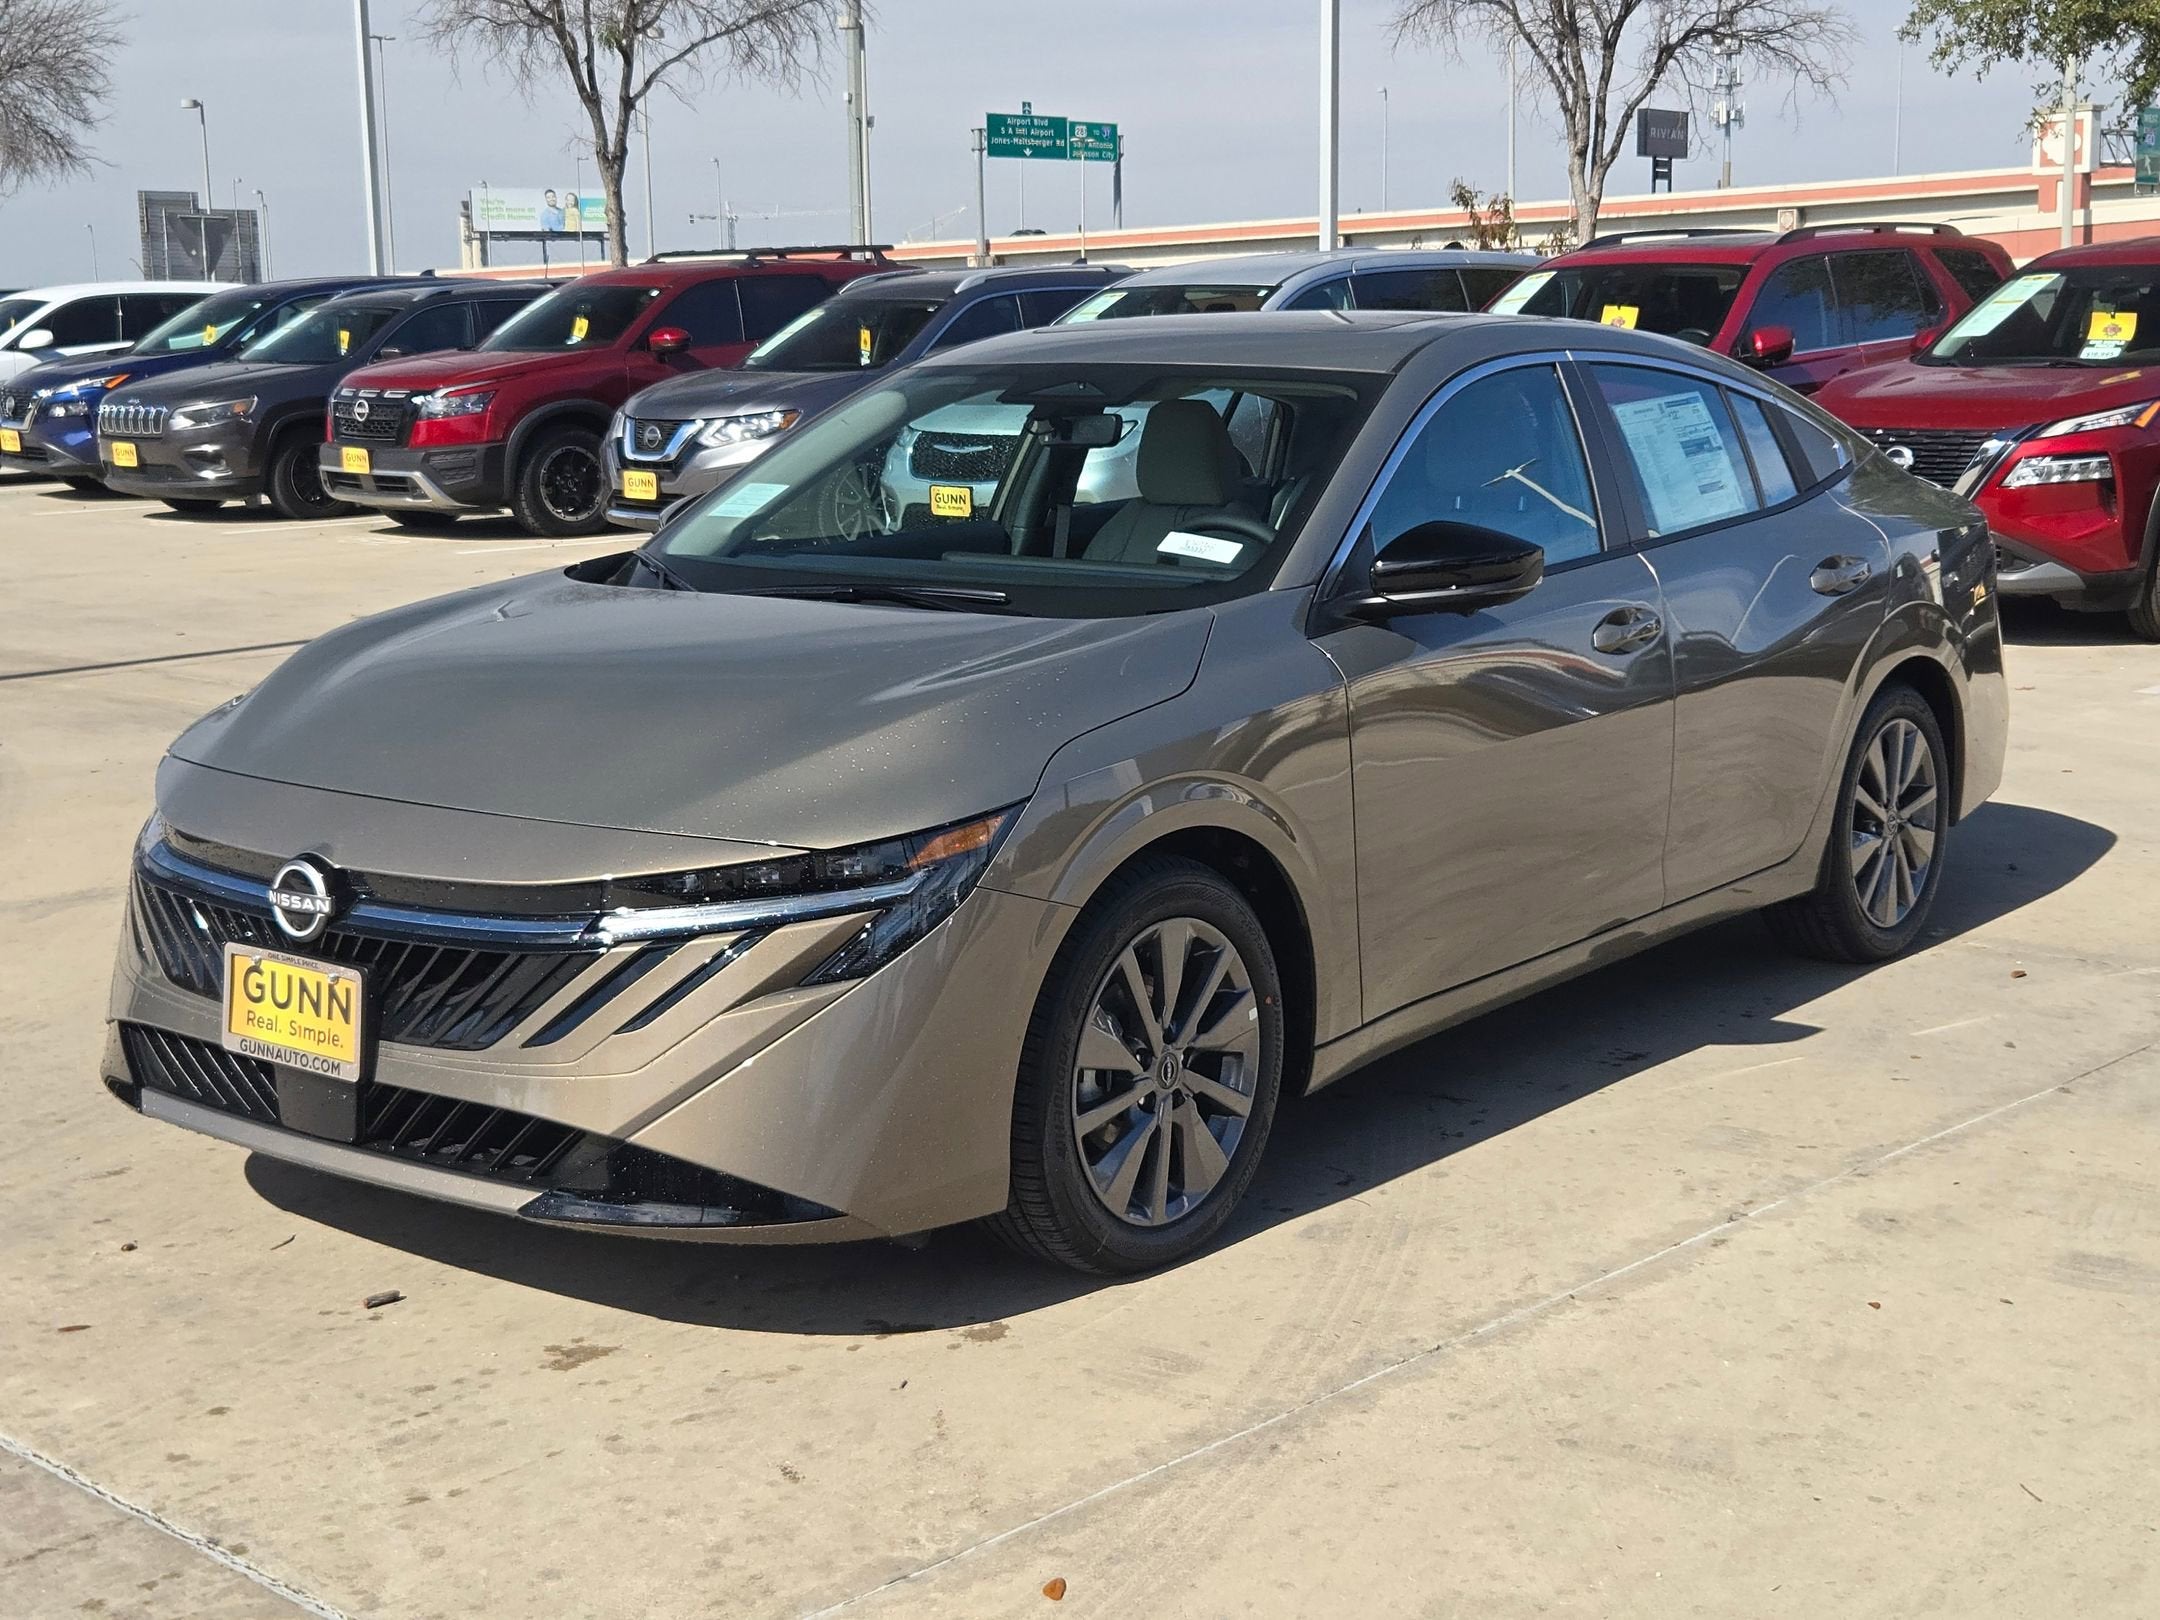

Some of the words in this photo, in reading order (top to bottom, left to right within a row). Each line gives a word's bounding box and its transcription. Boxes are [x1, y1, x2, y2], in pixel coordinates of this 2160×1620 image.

[1006, 117, 1031, 126] Airport
[1033, 118, 1049, 127] Blvd
[1000, 127, 1005, 135] S
[1008, 127, 1013, 135] A
[1030, 128, 1054, 137] Airport
[1650, 127, 1684, 140] RIVIAN
[1055, 139, 1065, 147] Rd
[1087, 141, 1114, 150] Antonio
[1101, 150, 1115, 160] City
[115, 447, 134, 456] GUNN
[345, 453, 367, 463] GUNN
[628, 477, 653, 488] GUNN
[934, 493, 966, 504] GUNN
[268, 889, 330, 913] NISSAN
[242, 964, 351, 1025] GUNN
[246, 1009, 282, 1034] Real.
[240, 1037, 340, 1076] GUNNAUTO.COM
